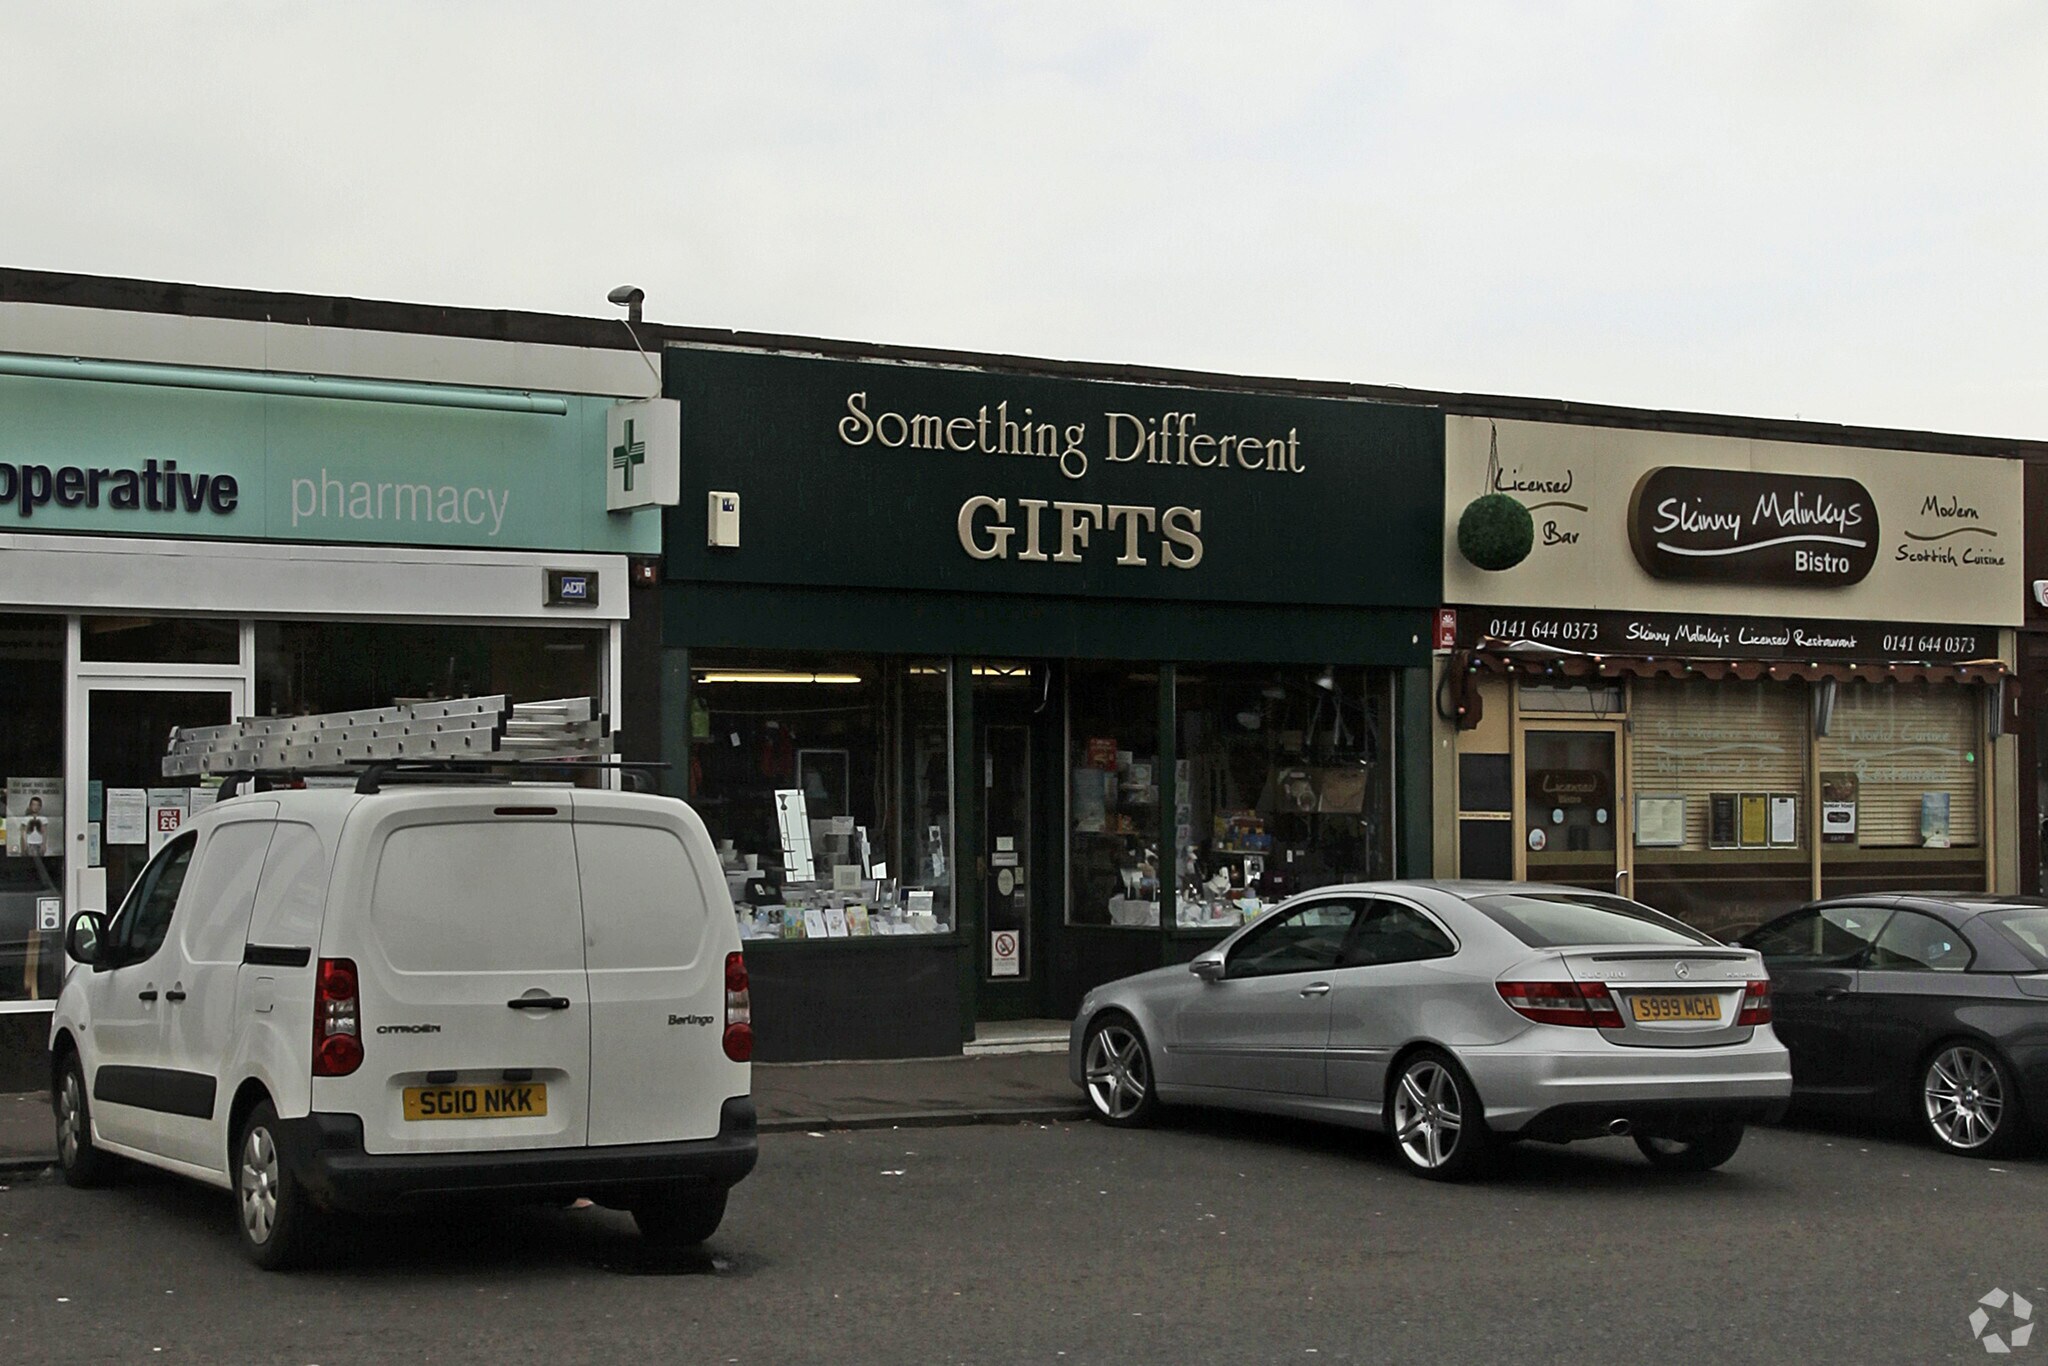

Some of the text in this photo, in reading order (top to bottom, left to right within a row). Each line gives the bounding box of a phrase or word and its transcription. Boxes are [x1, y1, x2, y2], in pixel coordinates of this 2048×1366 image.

[838, 392, 1306, 479] Something Different
[1495, 467, 1573, 493] Licensed
[291, 468, 510, 536] pharmacy
[1921, 495, 1979, 519] Modern
[1653, 491, 1863, 541] Skinny Malinkys
[957, 495, 1204, 569] GIFTS
[1543, 521, 1580, 546] Bar
[1795, 550, 1850, 574] Bistro
[1895, 544, 2006, 567] Scottish Cuisine
[563, 580, 585, 596] ADT
[1490, 619, 1599, 640] 0141 644 0373
[1625, 622, 1858, 648] Skinny Malinky's Licensed Restaurant
[1883, 634, 1976, 653] 0141 644 0373
[160, 818, 178, 830] £6
[1640, 997, 1715, 1017] S999 MCH
[668, 1014, 714, 1027] Berlingo
[419, 1089, 533, 1114] SG10 NKK
